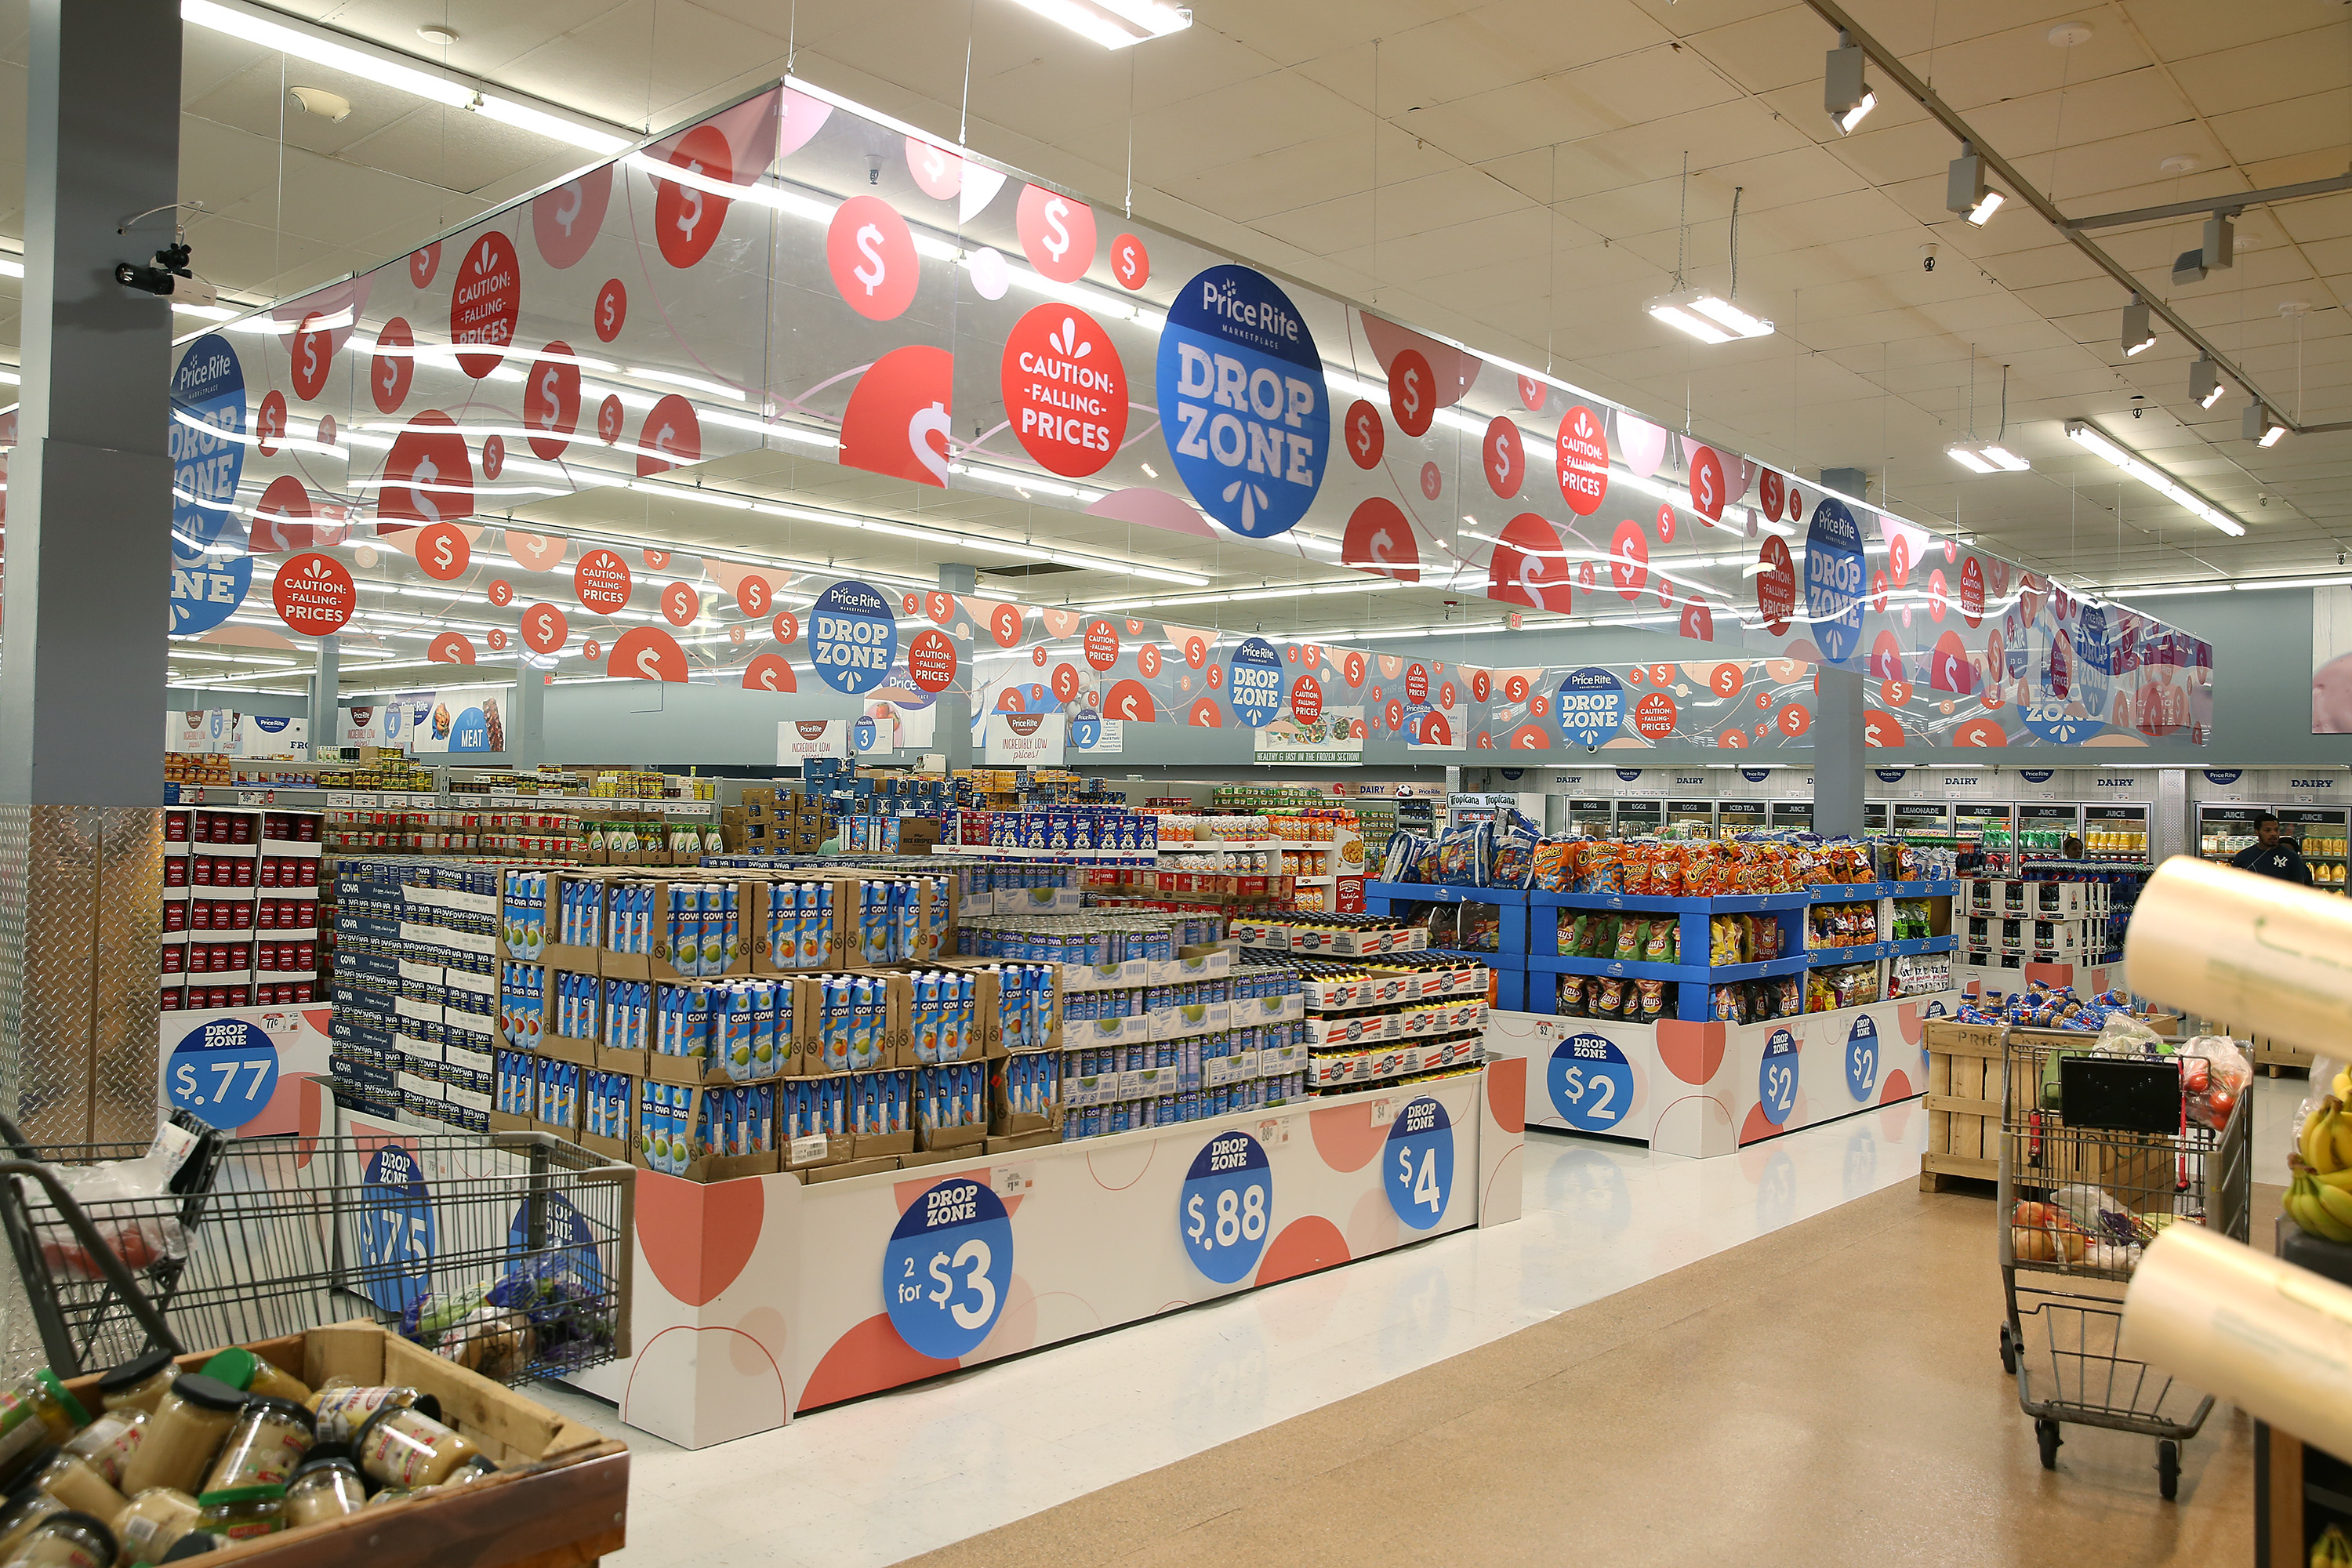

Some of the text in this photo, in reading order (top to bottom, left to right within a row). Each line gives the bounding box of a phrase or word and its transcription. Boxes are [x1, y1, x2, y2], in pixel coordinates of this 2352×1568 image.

[458, 274, 510, 305] CAUTION:
[459, 318, 508, 345] PRICES
[1222, 325, 1279, 350] MARKETPLACE
[1019, 352, 1113, 394] CAUTION:
[189, 384, 219, 399] MARKETPLACE
[1178, 342, 1315, 428] DROP
[1022, 408, 1110, 452] PRICES
[1176, 401, 1313, 487] ZONE
[1562, 436, 1602, 460] CAUTION:
[1562, 470, 1600, 497] PRICES
[582, 568, 626, 580] CAUTION:
[1811, 550, 1860, 592] DROP
[284, 578, 347, 594] CAUTION:
[583, 589, 623, 604] PRICES
[285, 605, 343, 622] PRICES
[1762, 599, 1791, 619] PRICES
[1810, 585, 1860, 629] ZONE
[1962, 601, 1982, 614] PRICES
[1511, 615, 1522, 628] EXIT
[817, 617, 888, 645] DROP
[1088, 636, 1116, 645] CAUTION:
[816, 644, 887, 670] ZONE
[914, 650, 952, 660] CAUTION:
[1089, 652, 1114, 662] PRICES
[915, 670, 949, 682] PRICES
[1234, 667, 1279, 688] DROP
[1233, 687, 1278, 708] ZONE
[1295, 691, 1319, 699] CAUTION:
[1408, 688, 1425, 697] PRICES
[1563, 694, 1617, 711] DROP
[1295, 706, 1318, 716] PRICES
[214, 719, 219, 735] 5
[389, 717, 395, 733] 4
[1562, 711, 1618, 728] ZONE
[1641, 722, 1671, 731] PRICES
[462, 730, 483, 747] MEAT
[860, 729, 869, 747] 3
[1081, 724, 1091, 743] 2
[791, 742, 831, 753] INCREDIBLY LOW
[1002, 739, 1047, 750] INCREDIBLY LOW
[1013, 750, 1040, 762] prices!
[1257, 752, 1278, 762] HEALTHY
[1285, 753, 1297, 761] FAST
[1316, 752, 1335, 761] FROZEN
[1337, 752, 1359, 761] SECTION!
[1360, 786, 1385, 794] DAIRY
[1450, 795, 1479, 805] Tropicana
[1484, 794, 1515, 807] Tropicana
[1902, 806, 1939, 815] LEMONADE
[1534, 847, 1563, 866] Cheetos
[342, 883, 359, 893] GOYA
[341, 918, 358, 929] GOYA
[340, 955, 356, 965] GOYA
[337, 990, 353, 1001] GOYA
[1929, 1004, 1942, 1013] DROP
[205, 1025, 249, 1037] DROP
[336, 1025, 351, 1036] GOYA
[1539, 1026, 1548, 1036] $2
[1857, 1018, 1870, 1029] DROP
[1857, 1025, 1871, 1037] ZONE
[205, 1035, 247, 1047] ZONE
[1573, 1037, 1607, 1050] DROP
[1772, 1033, 1789, 1046] DROP
[1573, 1047, 1607, 1060] ZONE
[1772, 1042, 1790, 1054] ZONE
[336, 1062, 351, 1073] GOYA
[1853, 1046, 1873, 1090] $2
[176, 1060, 272, 1106] $.77
[1768, 1064, 1792, 1111] $2
[1564, 1065, 1616, 1120] $2
[1407, 1102, 1436, 1119] DROP
[1406, 1115, 1435, 1132] ZONE
[1211, 1138, 1248, 1156] DROP
[380, 1150, 411, 1173] DROP
[1210, 1152, 1247, 1171] ZONE
[379, 1167, 409, 1190] ZONE
[1399, 1145, 1441, 1214] $4
[927, 1184, 978, 1211] DROP
[927, 1203, 977, 1227] ZONE
[1187, 1183, 1267, 1251] $.88
[903, 1257, 916, 1279] 2
[928, 1238, 996, 1330] $3
[898, 1282, 922, 1305] for
